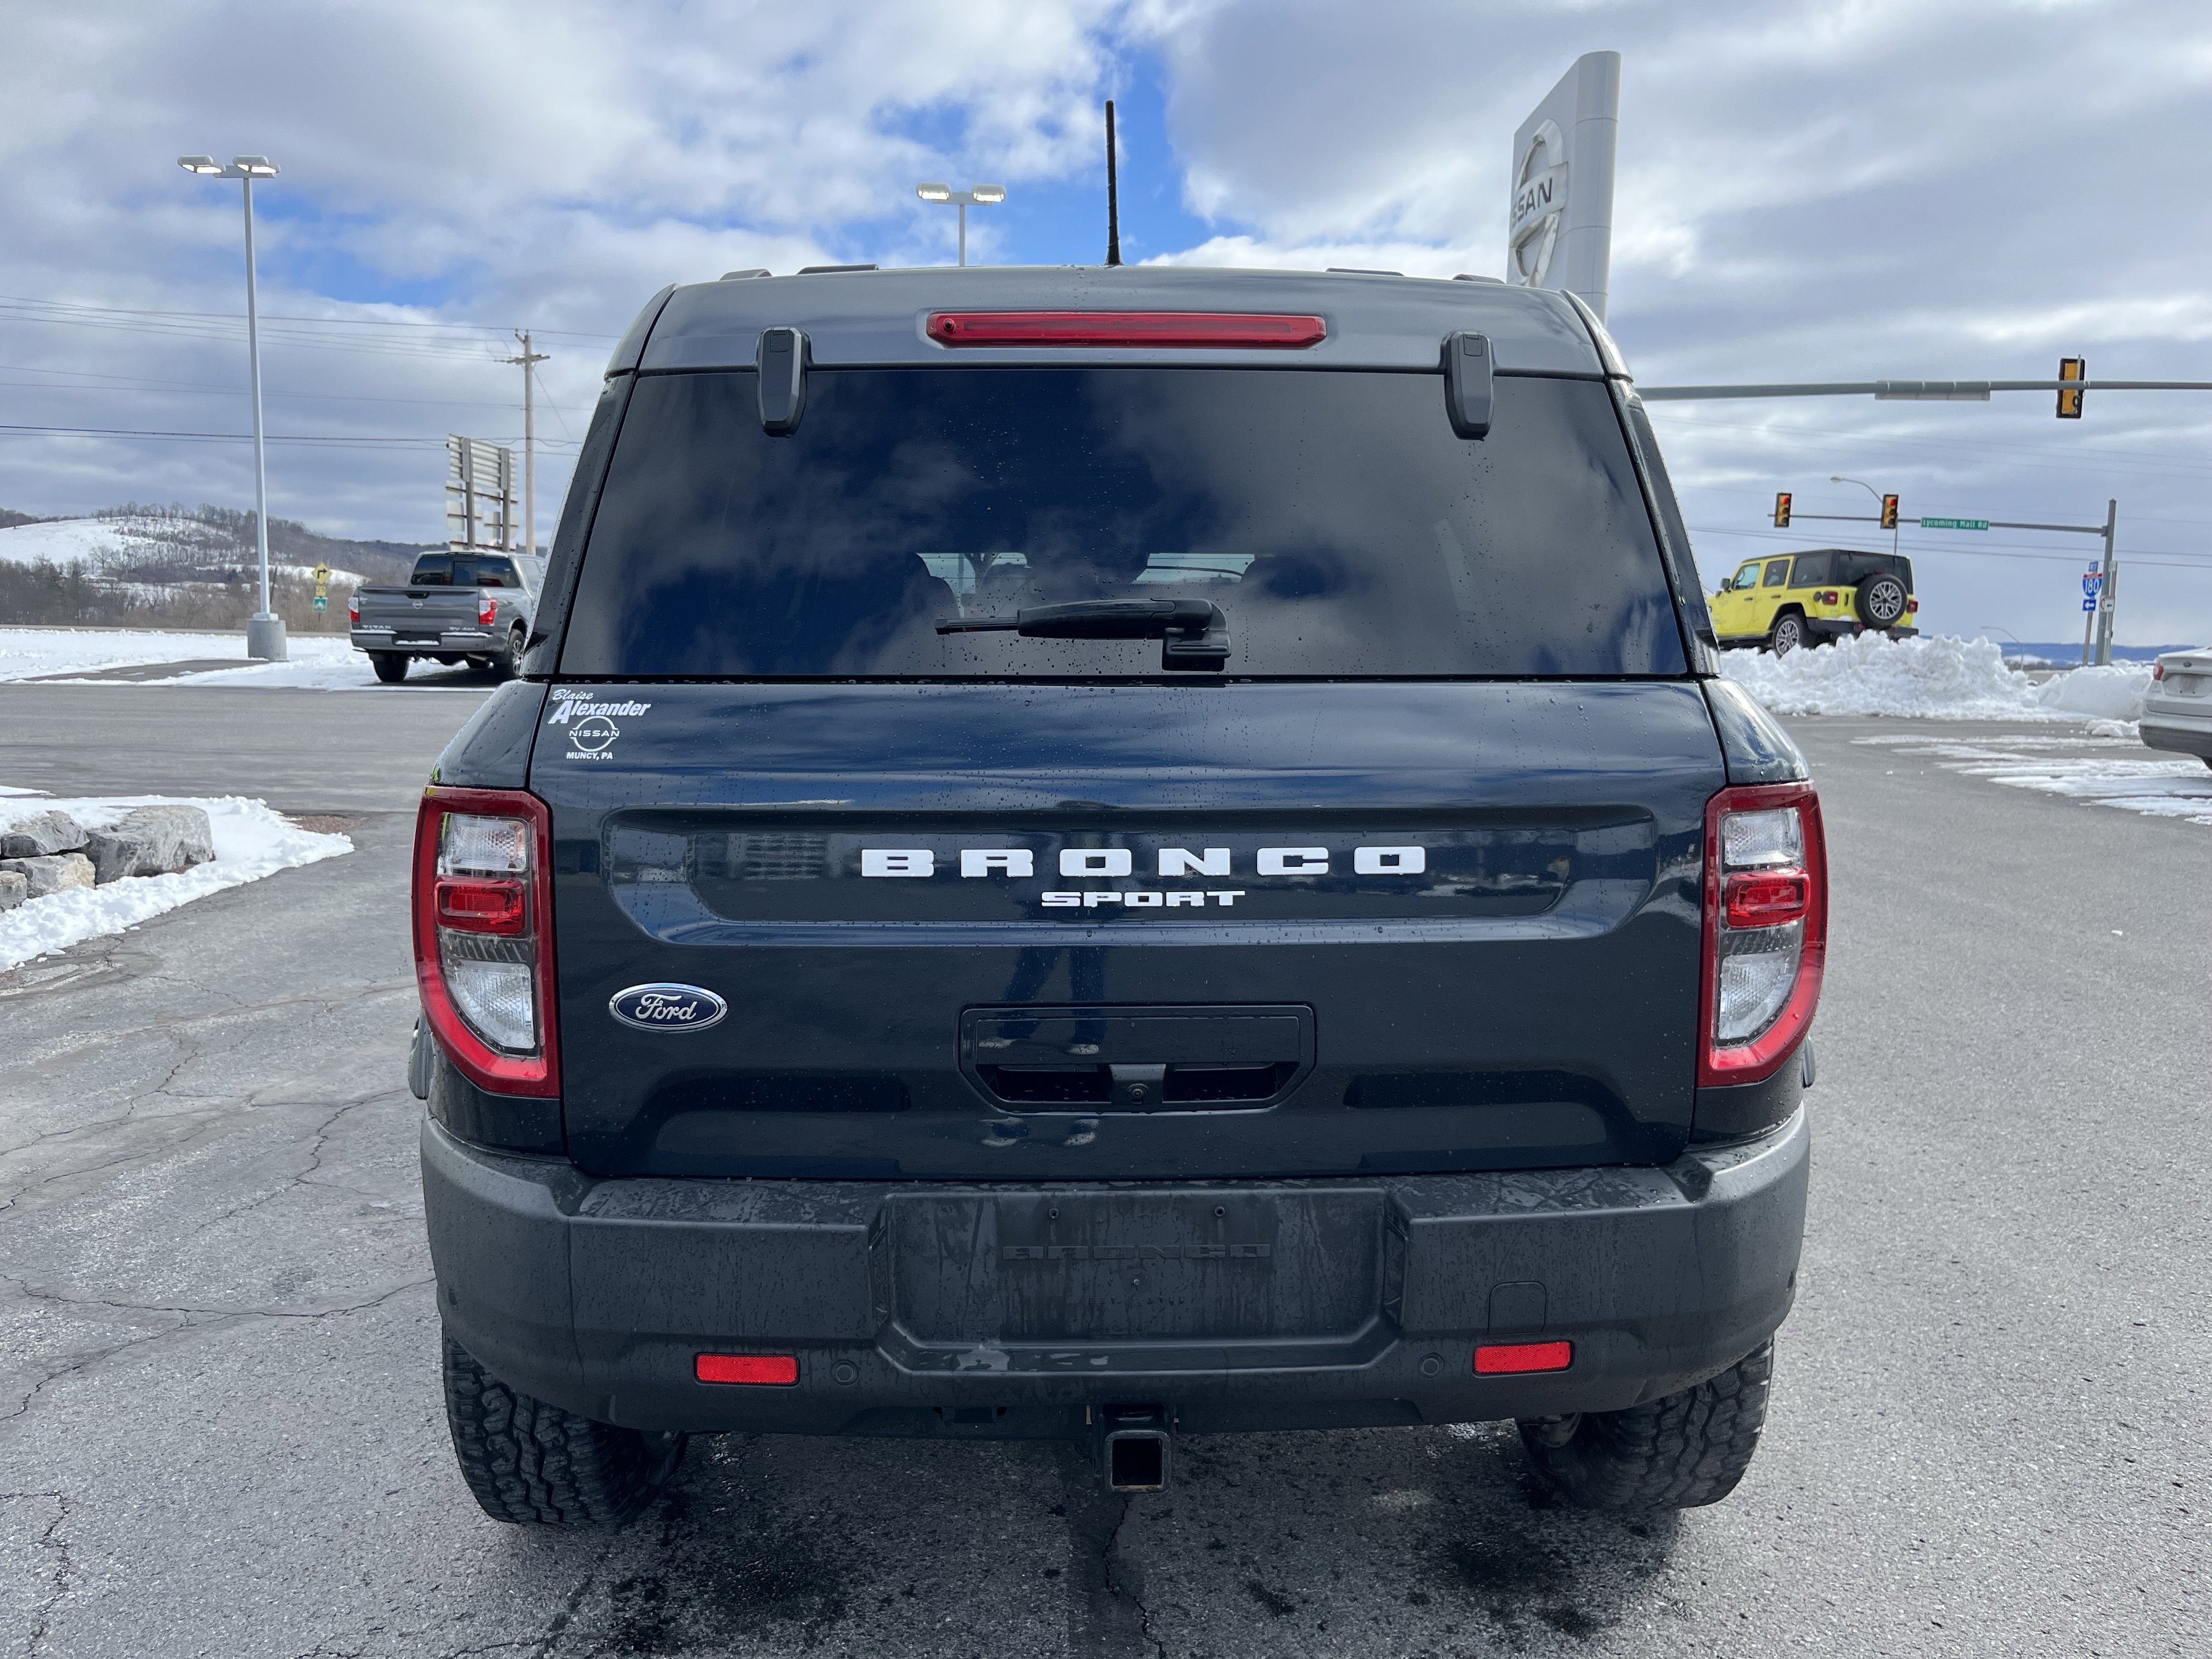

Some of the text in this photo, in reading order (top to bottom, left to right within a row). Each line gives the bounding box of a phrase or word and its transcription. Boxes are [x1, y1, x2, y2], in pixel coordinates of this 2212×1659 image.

[1923, 518, 1957, 529] Lycoming
[1960, 520, 1976, 528] Mall
[2085, 578, 2100, 594] 180
[552, 689, 594, 700] Blaise
[548, 700, 651, 724] Alexander
[566, 752, 600, 761] MUNCY,
[861, 846, 1425, 877] BRONCO
[1042, 891, 1245, 907] SPORT
[635, 994, 698, 1020] Ford
[1003, 1244, 1271, 1260] BRONCO
